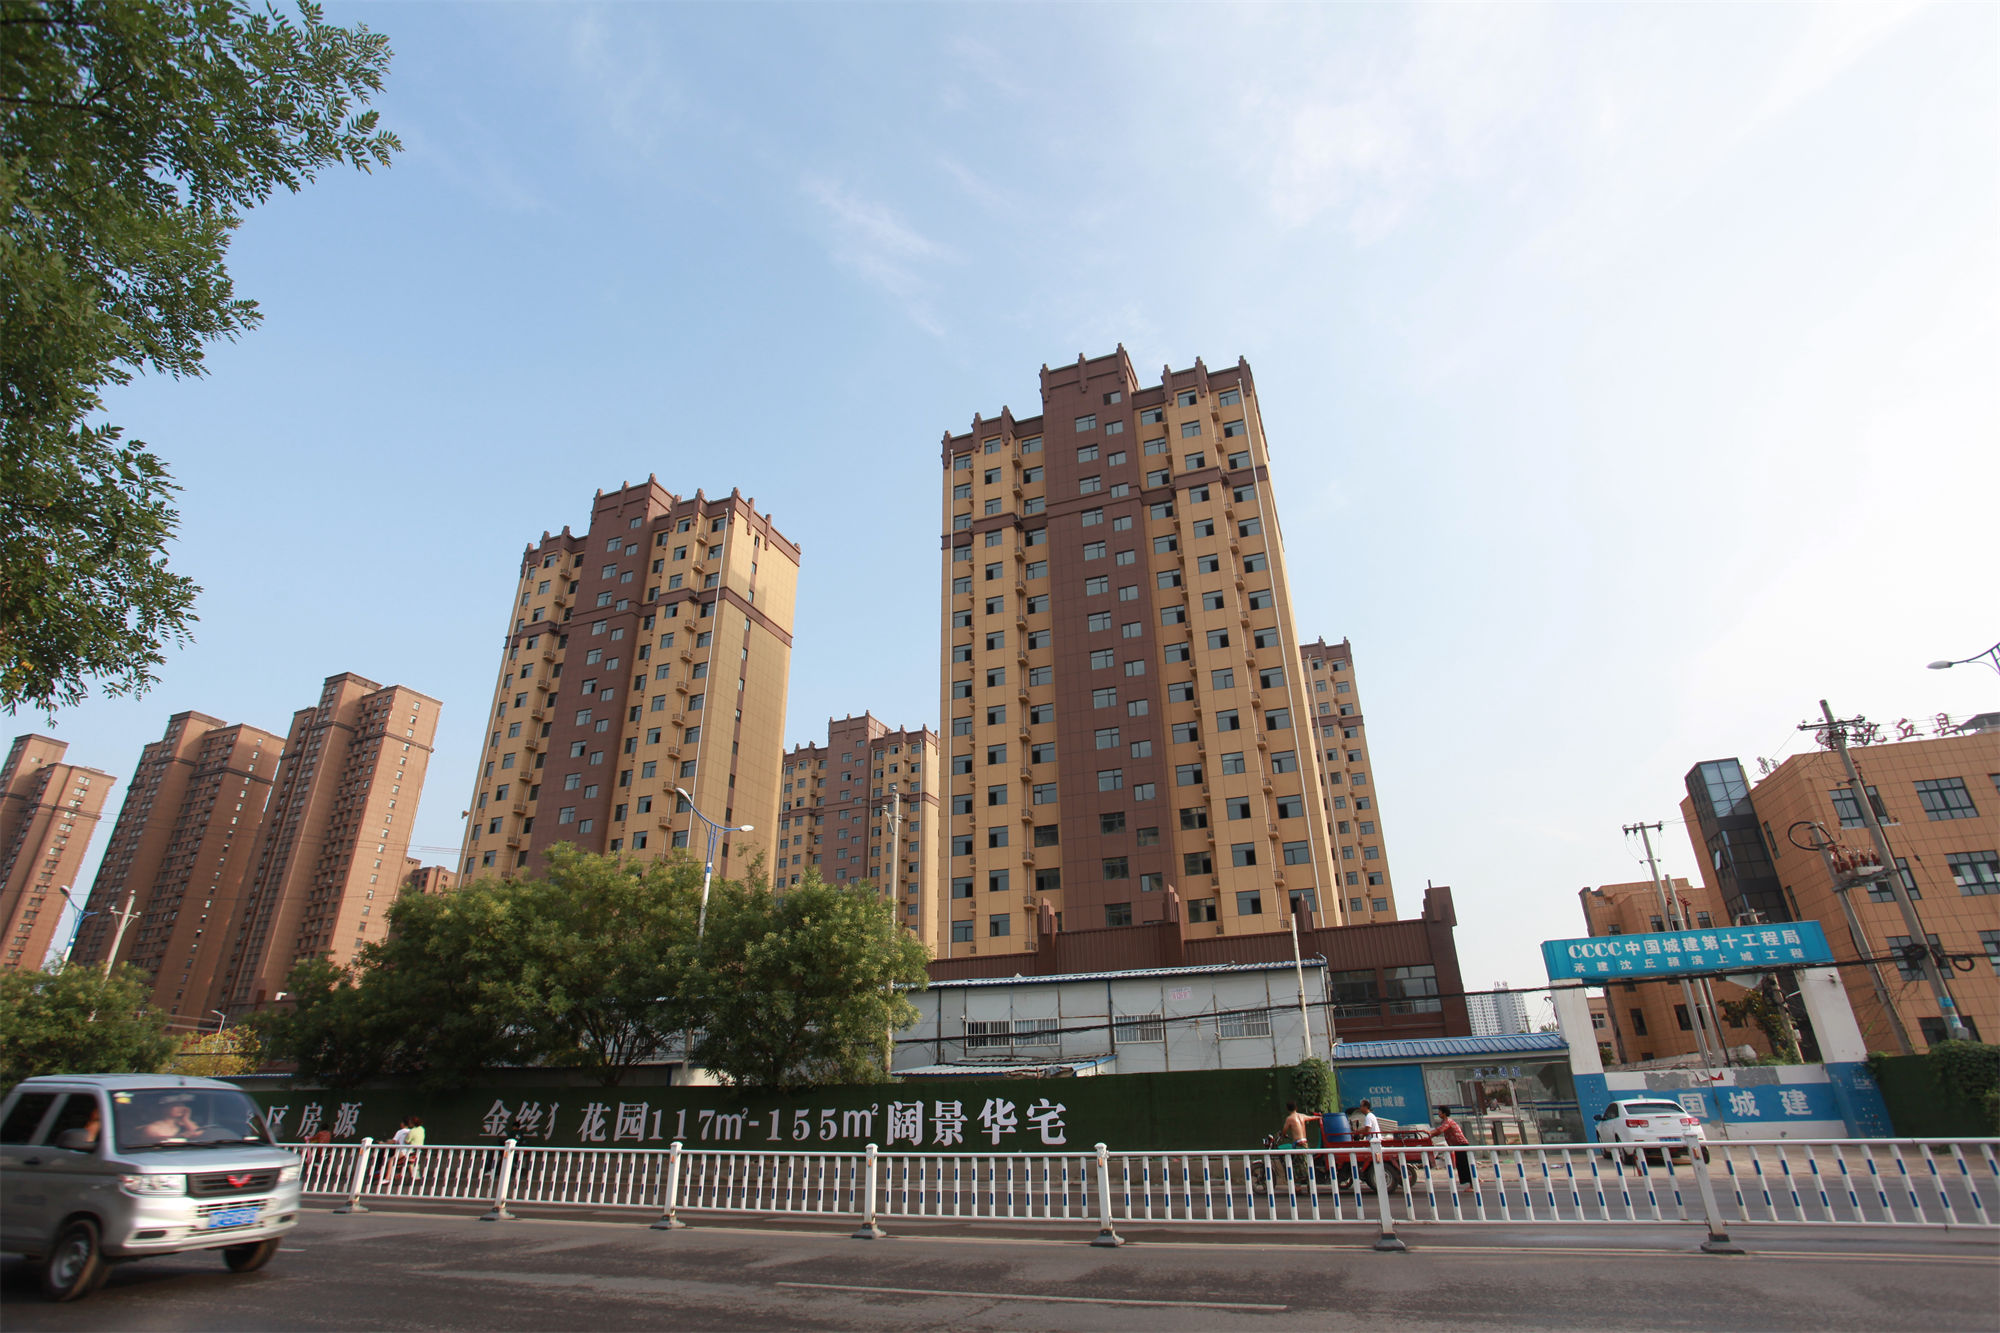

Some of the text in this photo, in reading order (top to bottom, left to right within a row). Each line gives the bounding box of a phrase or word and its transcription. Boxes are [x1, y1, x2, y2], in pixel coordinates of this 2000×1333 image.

[1360, 1096, 1406, 1109] 国城建
[1637, 1089, 1812, 1119] 国城建
